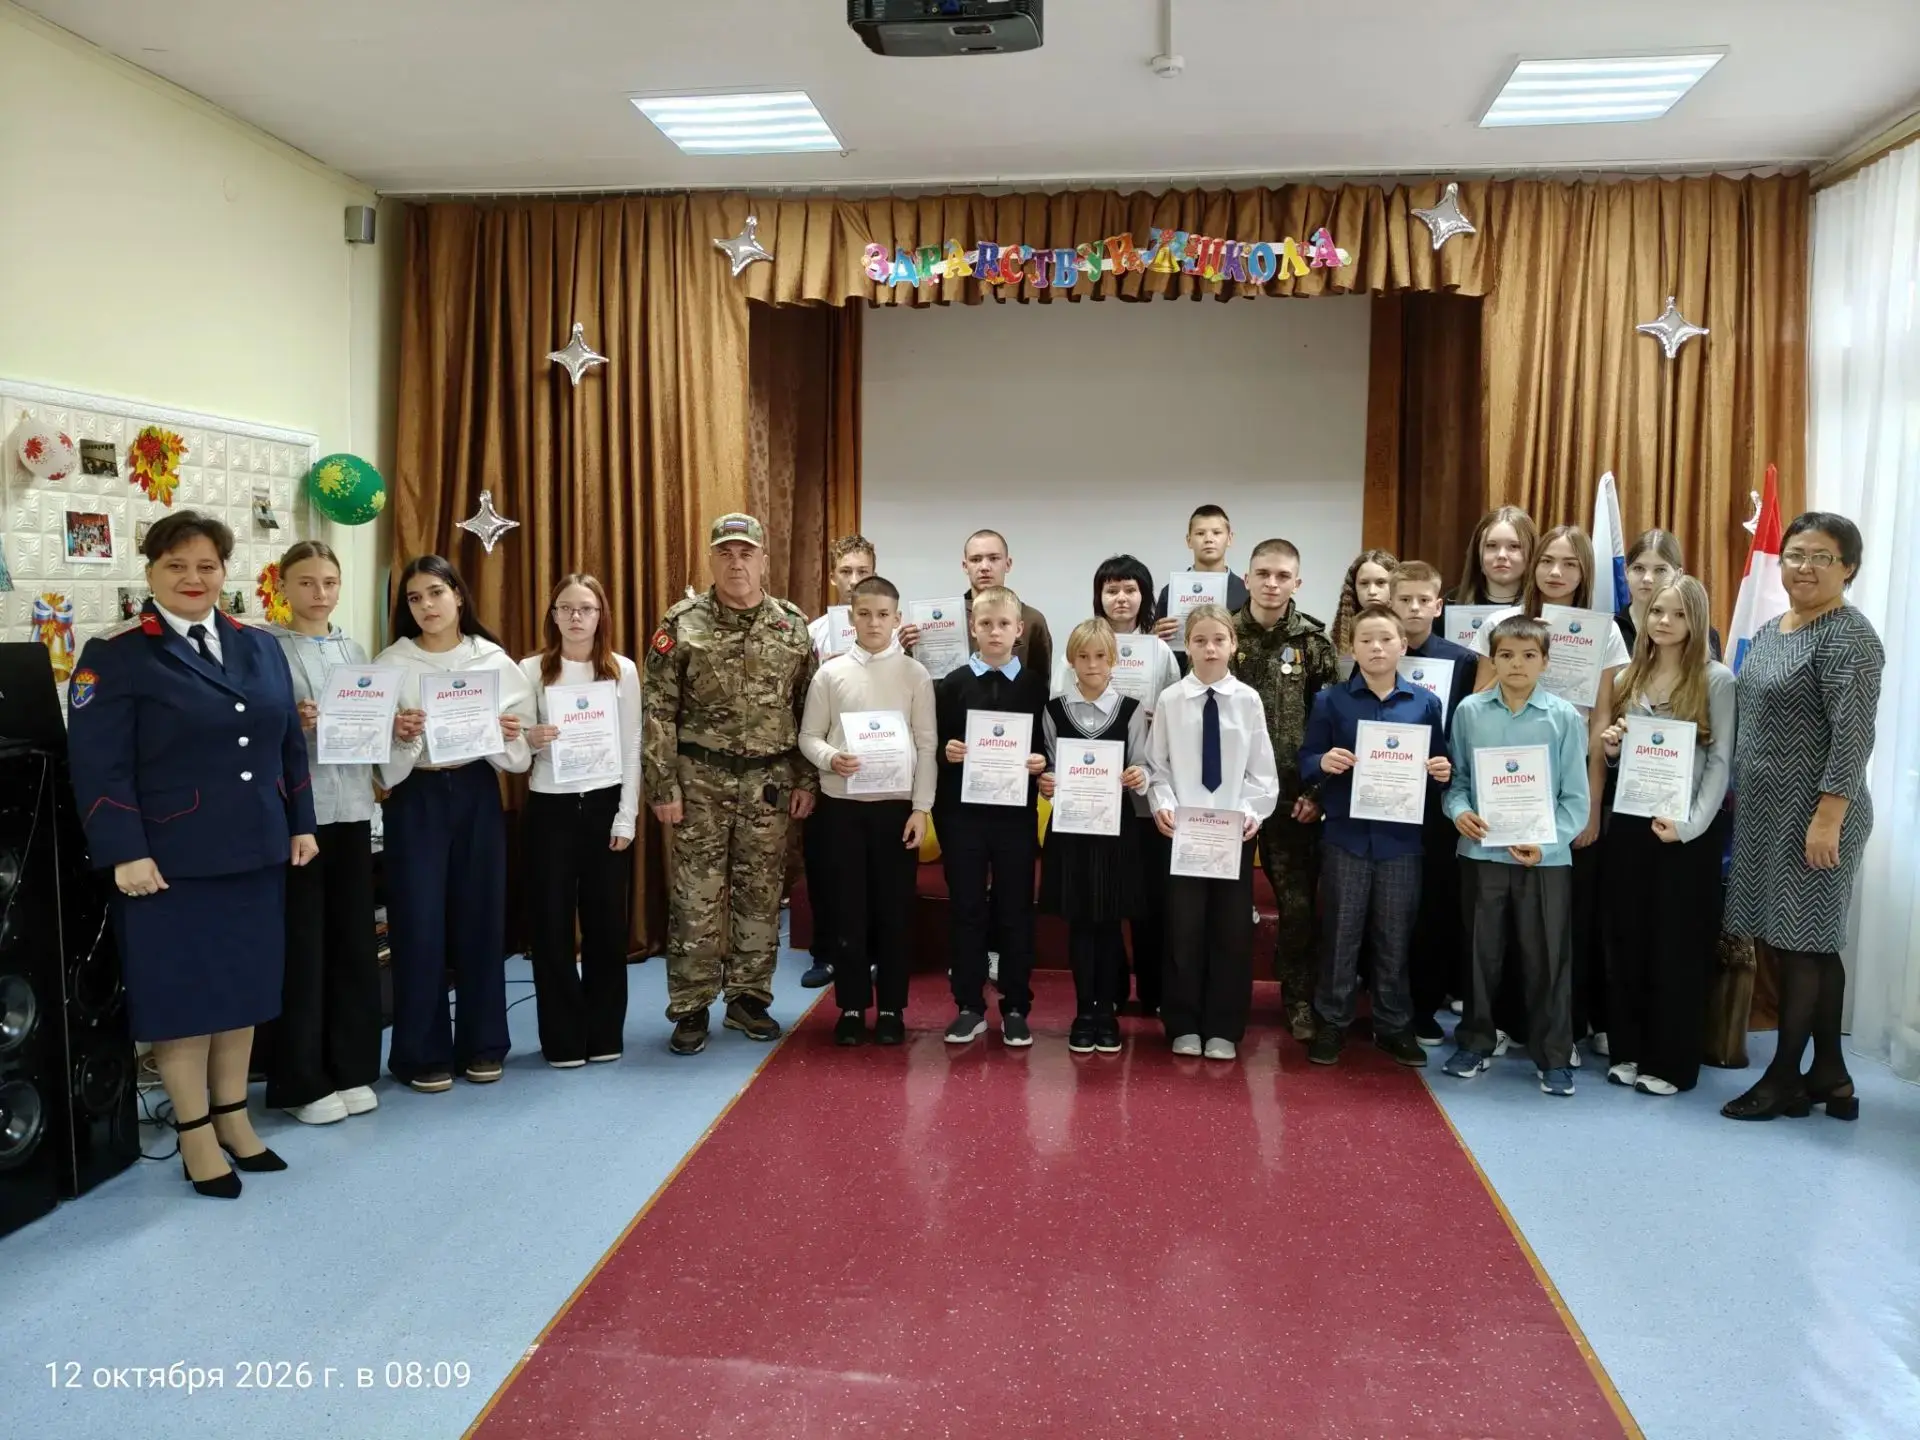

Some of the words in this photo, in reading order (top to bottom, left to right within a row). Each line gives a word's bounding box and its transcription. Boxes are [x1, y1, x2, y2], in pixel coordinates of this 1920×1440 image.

[1180, 595, 1215, 603] ДИПЛОМ
[923, 621, 955, 631] ДИПЛОМ
[1552, 634, 1593, 646] ДИПЛОМ
[337, 689, 384, 698] ДИПЛОМ
[437, 689, 483, 700] ДИПЛОМ
[563, 710, 605, 723] ДИПЛОМ
[858, 731, 897, 740] ДИПЛОМ
[979, 738, 1018, 748] ДИПЛОМ
[1370, 750, 1413, 761] ДИПЛОМ
[1635, 744, 1679, 757] ДИПЛОМ
[1069, 766, 1109, 776] ДИПЛОМ
[1492, 774, 1536, 785] ДИПЛОМ
[1188, 816, 1230, 826] ДИПЛОМ
